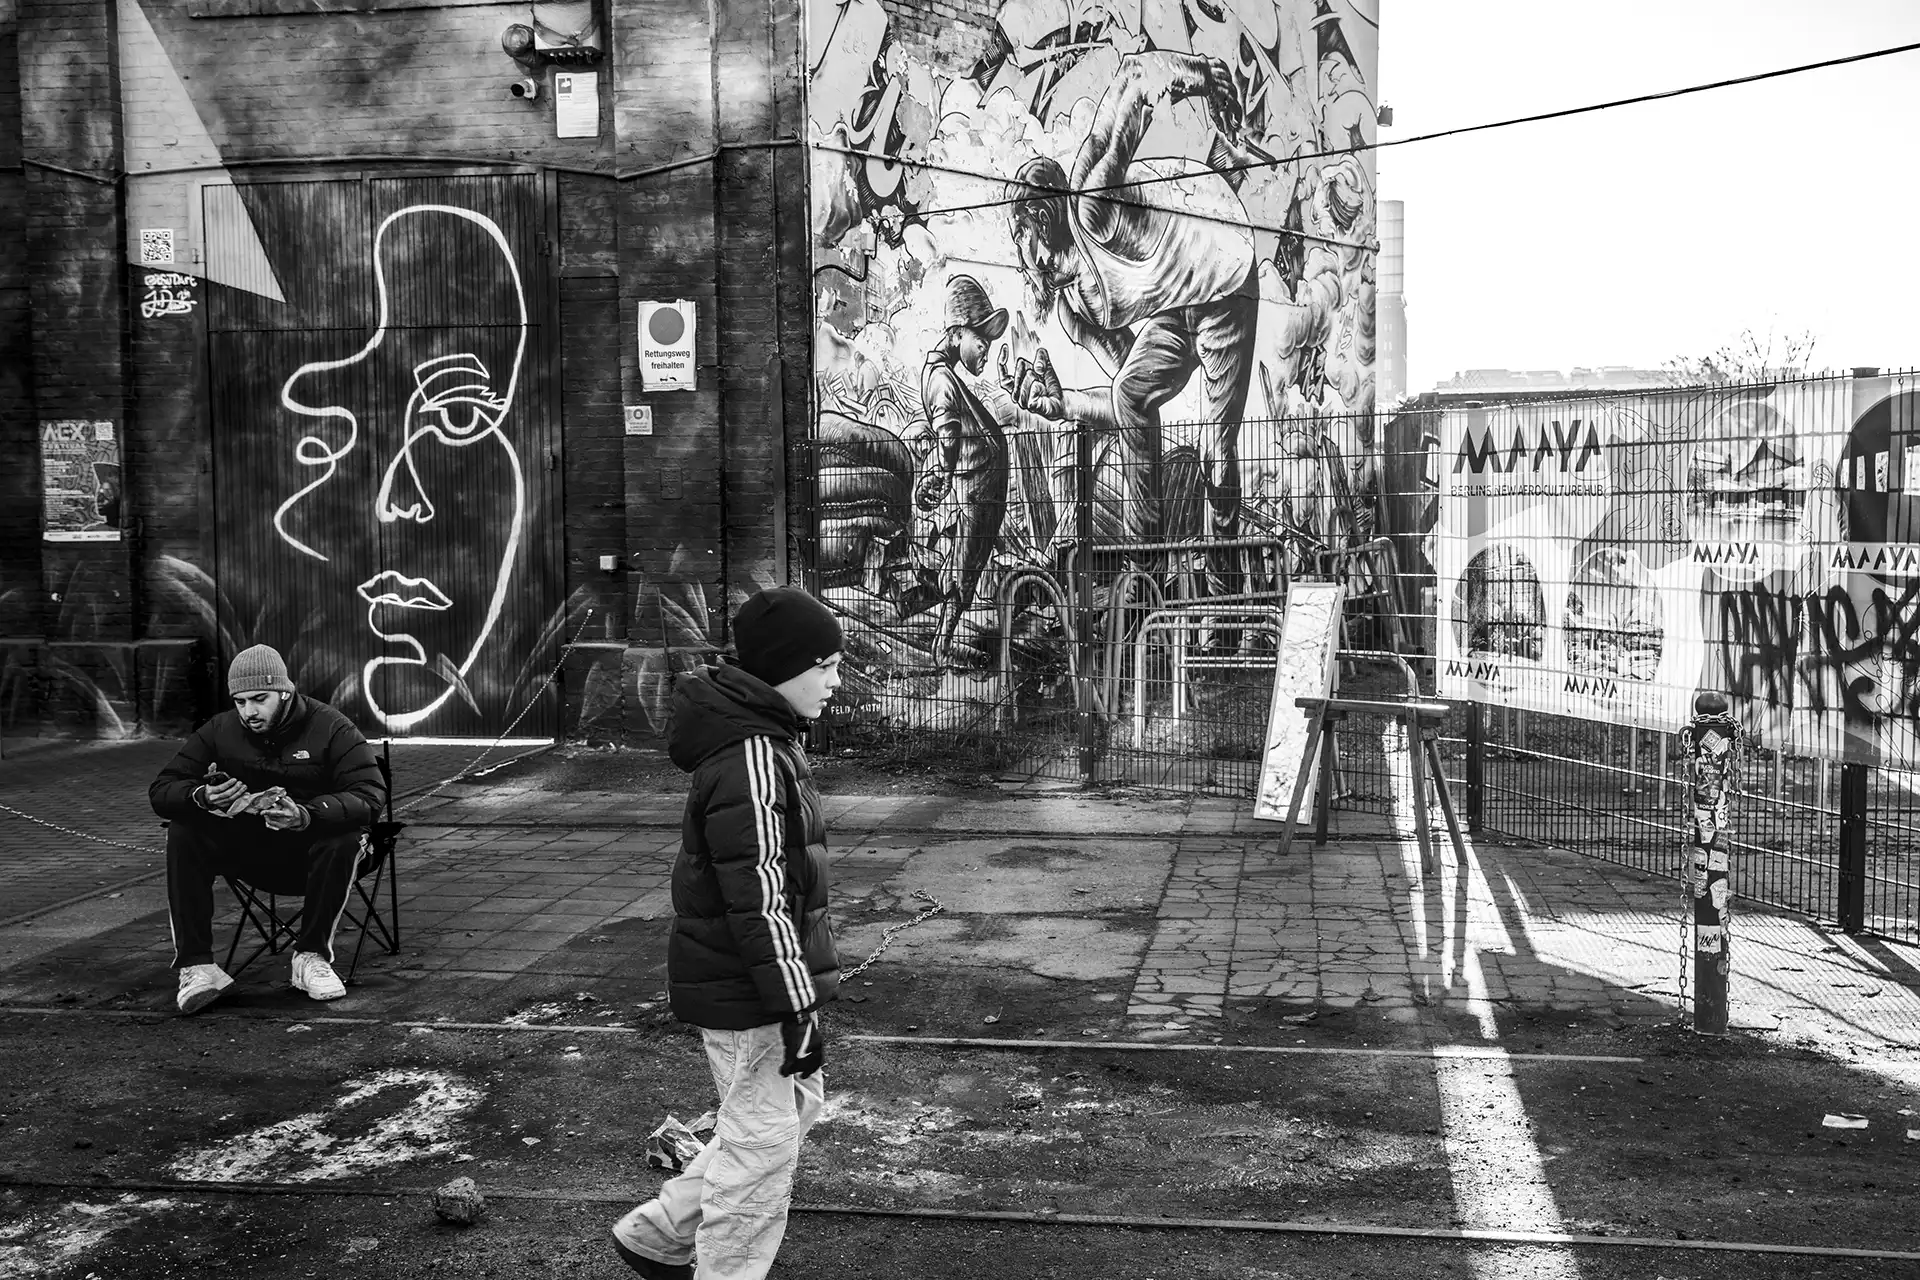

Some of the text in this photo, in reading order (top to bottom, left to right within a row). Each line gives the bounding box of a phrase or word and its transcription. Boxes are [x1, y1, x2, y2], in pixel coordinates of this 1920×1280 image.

[645, 350, 690, 358] Rettungsweg
[651, 361, 685, 369] freihalten
[1453, 420, 1601, 473] MAAYA
[1451, 485, 1491, 496] BERLINS
[1494, 485, 1517, 496] NEW
[1584, 485, 1603, 496] HUB
[1693, 543, 1759, 564] MAAYA
[1832, 547, 1917, 571] MAAYA
[1446, 661, 1500, 680] MAAYA
[1565, 675, 1617, 698] MAAYA
